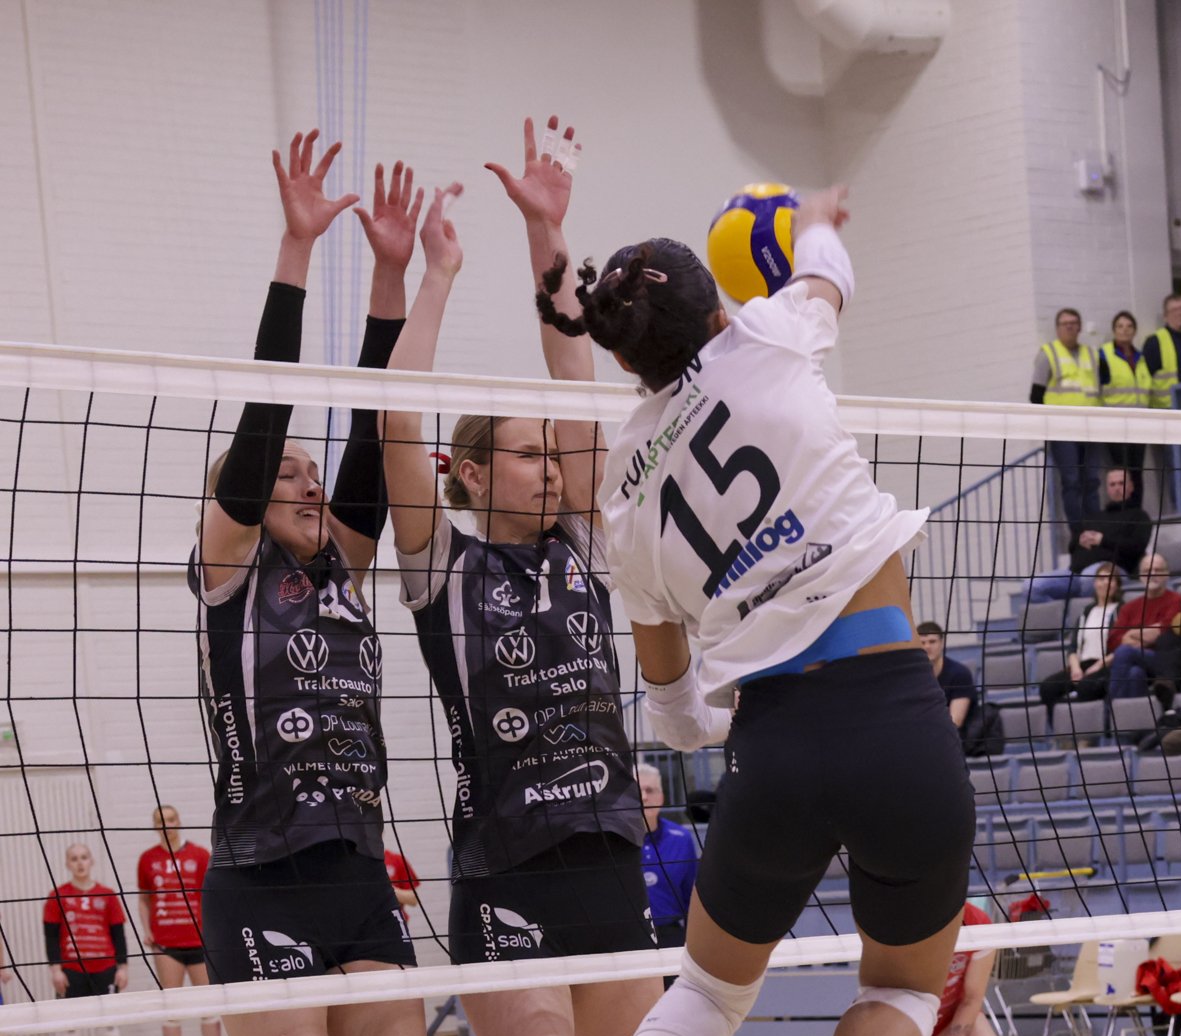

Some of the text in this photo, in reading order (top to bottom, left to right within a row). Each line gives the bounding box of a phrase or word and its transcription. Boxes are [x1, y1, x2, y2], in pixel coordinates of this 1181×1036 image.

[659, 399, 781, 600] 15
[293, 675, 372, 694] Traktoauto
[503, 657, 593, 688] Traktoauto
[551, 677, 587, 697] Salo
[479, 903, 532, 951] CRAFT salo
[241, 926, 305, 975] CRAFT salo
